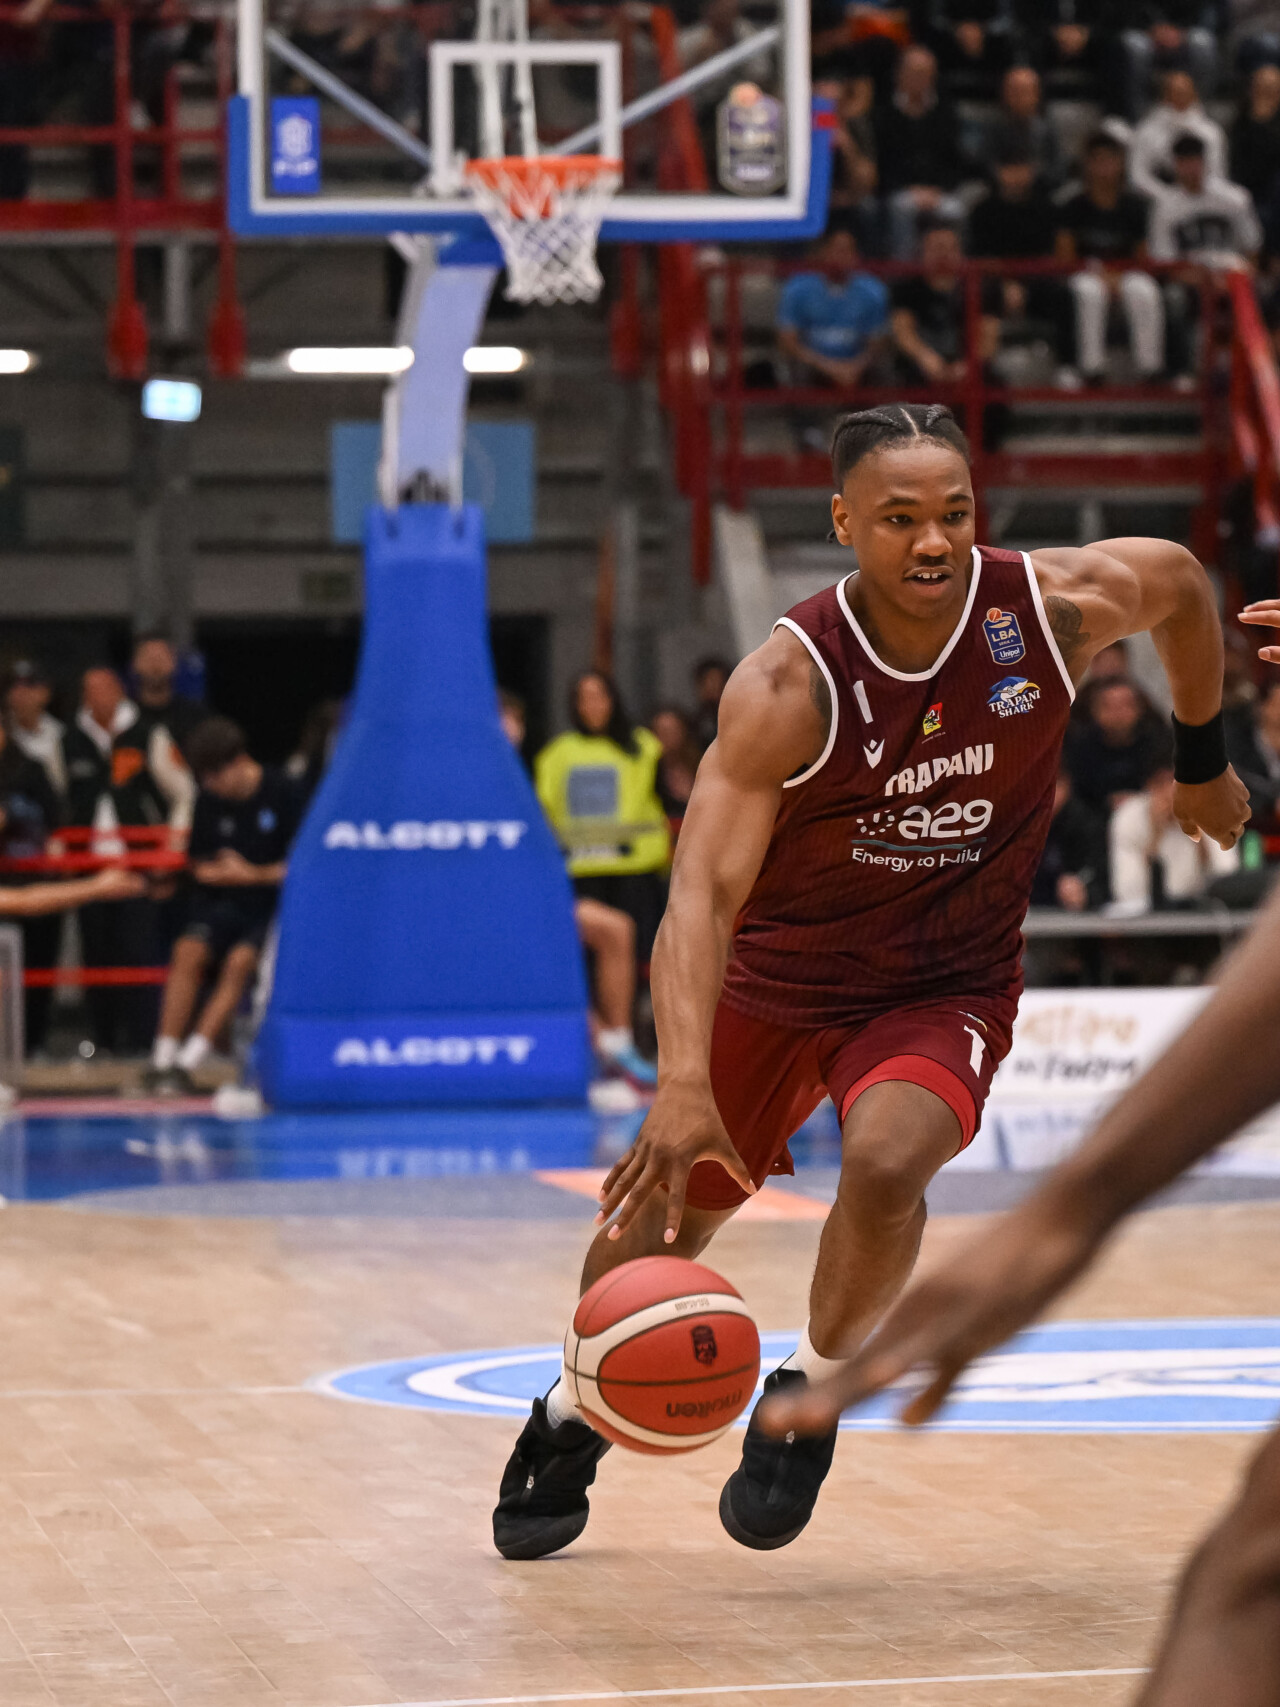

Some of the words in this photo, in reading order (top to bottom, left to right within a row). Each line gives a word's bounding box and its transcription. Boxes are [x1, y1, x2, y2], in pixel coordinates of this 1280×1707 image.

[991, 628, 1018, 642] LBA
[1000, 647, 1020, 659] Unipol
[853, 680, 874, 724] 1
[988, 690, 1041, 713] TRAPANI
[998, 701, 1034, 718] SHARK
[884, 743, 994, 796] TRAPANI
[898, 799, 994, 840] a29
[325, 820, 528, 850] ALCOTT
[852, 848, 914, 873] Energy
[917, 858, 934, 867] to
[334, 1035, 537, 1067] ALCOTT
[963, 1024, 986, 1078] 1
[666, 1389, 743, 1418] molten
